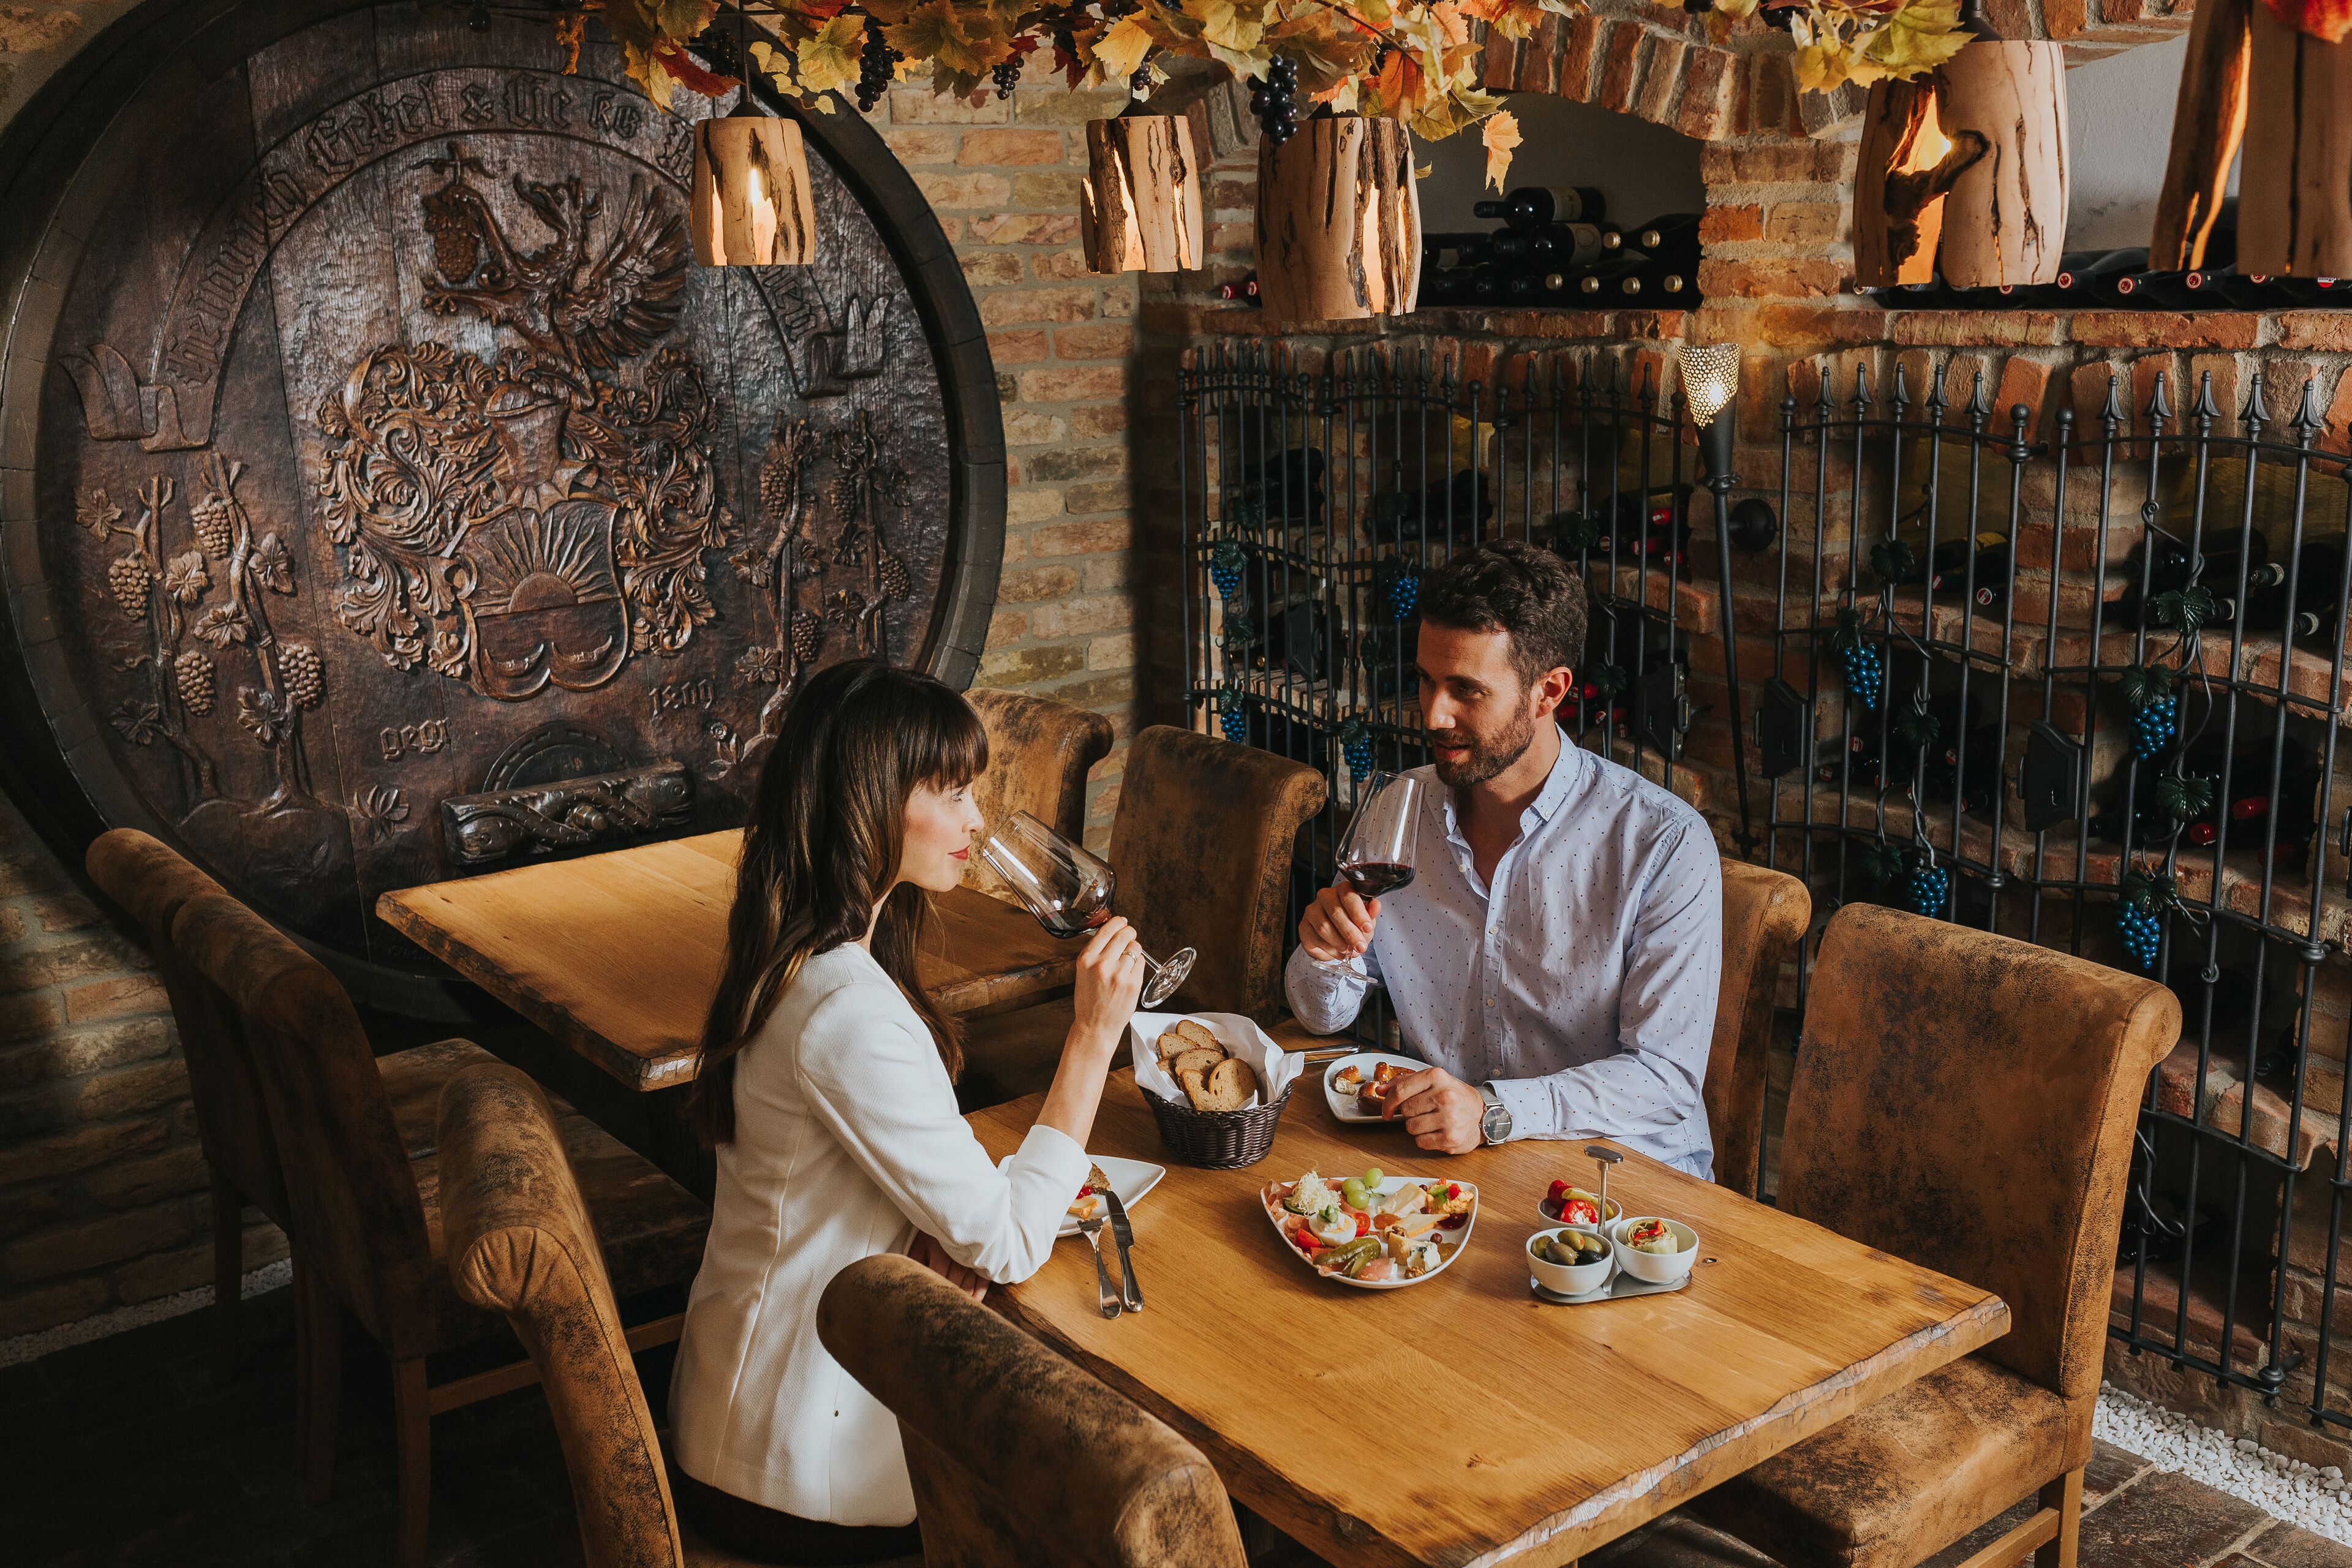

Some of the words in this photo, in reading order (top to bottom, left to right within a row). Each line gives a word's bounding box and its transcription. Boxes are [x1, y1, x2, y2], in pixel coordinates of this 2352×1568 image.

[307, 74, 450, 175] Eckel
[460, 83, 494, 124] &
[503, 72, 572, 128] Cie
